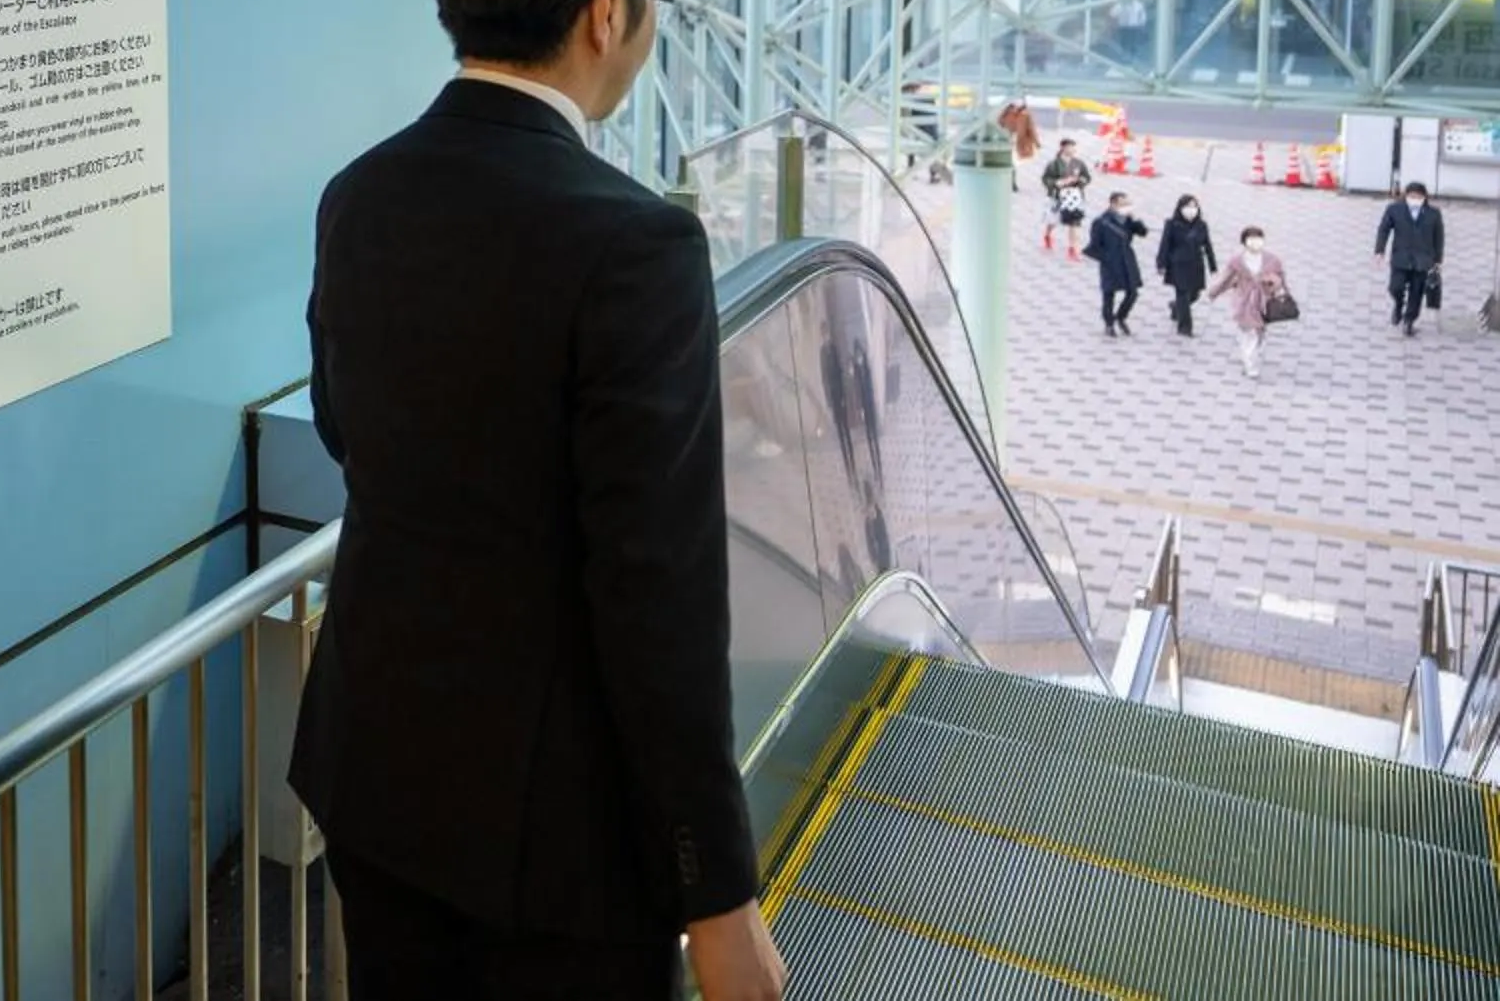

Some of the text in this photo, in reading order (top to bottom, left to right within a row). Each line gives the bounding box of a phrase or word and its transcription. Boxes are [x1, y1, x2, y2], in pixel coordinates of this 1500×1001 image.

[11, 21, 22, 34] of
[24, 18, 38, 32] the
[39, 15, 77, 31] Escalator
